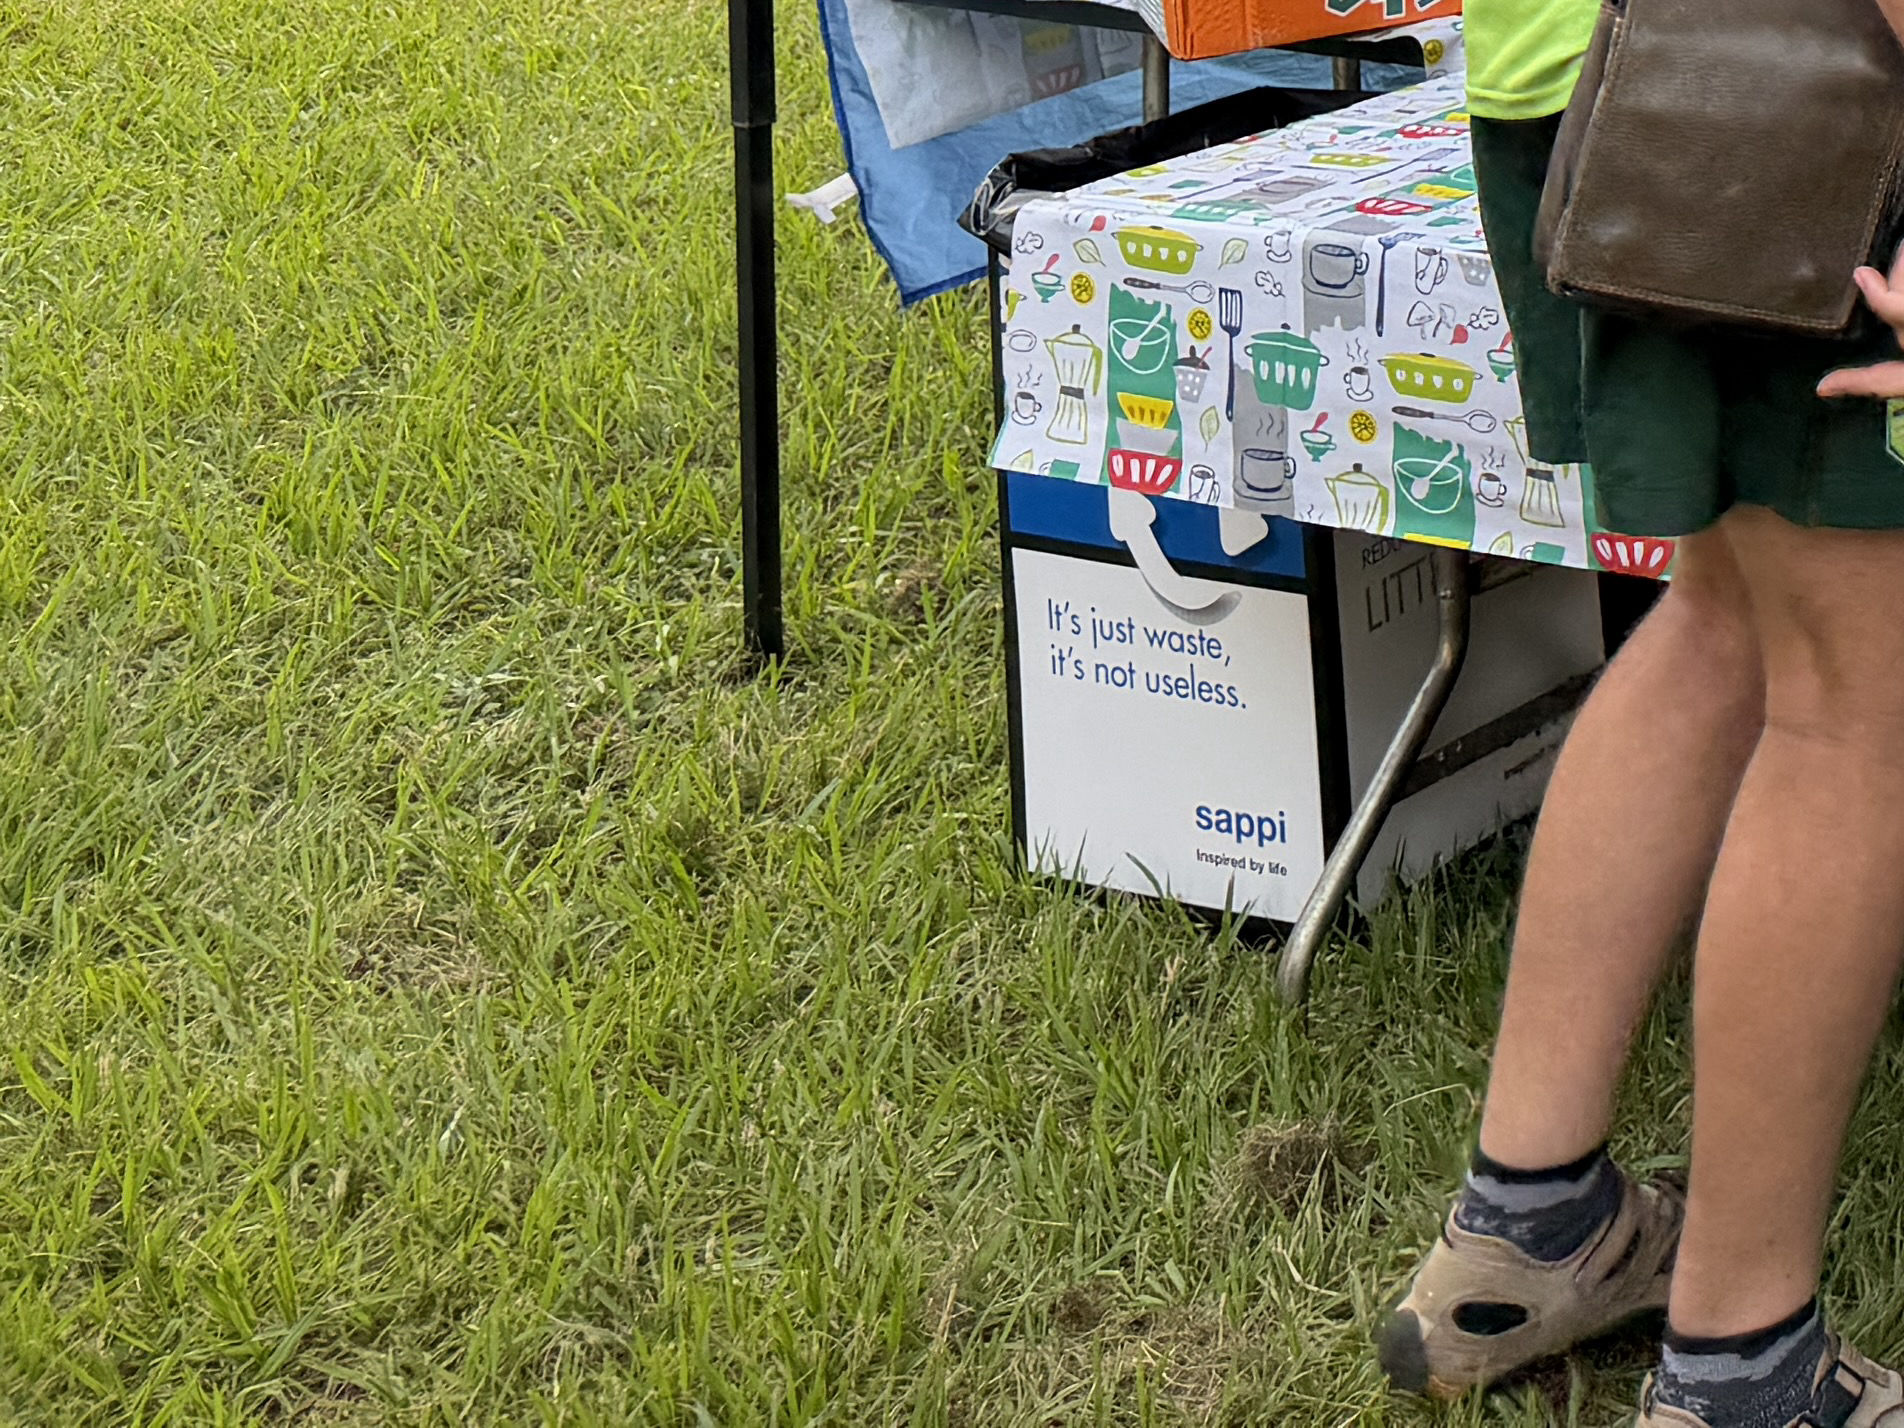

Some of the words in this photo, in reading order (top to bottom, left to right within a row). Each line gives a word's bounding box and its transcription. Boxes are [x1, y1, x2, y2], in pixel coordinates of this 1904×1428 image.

[1048, 598, 1081, 635] It's
[1091, 606, 1135, 649] just
[1144, 626, 1231, 667] waste,
[1050, 644, 1085, 680] it's
[1095, 661, 1136, 689] not
[1145, 663, 1247, 709] useless.
[1195, 804, 1287, 847] sappi
[1196, 848, 1246, 870] Inspired
[1250, 858, 1265, 875] by
[1268, 861, 1288, 876] life
